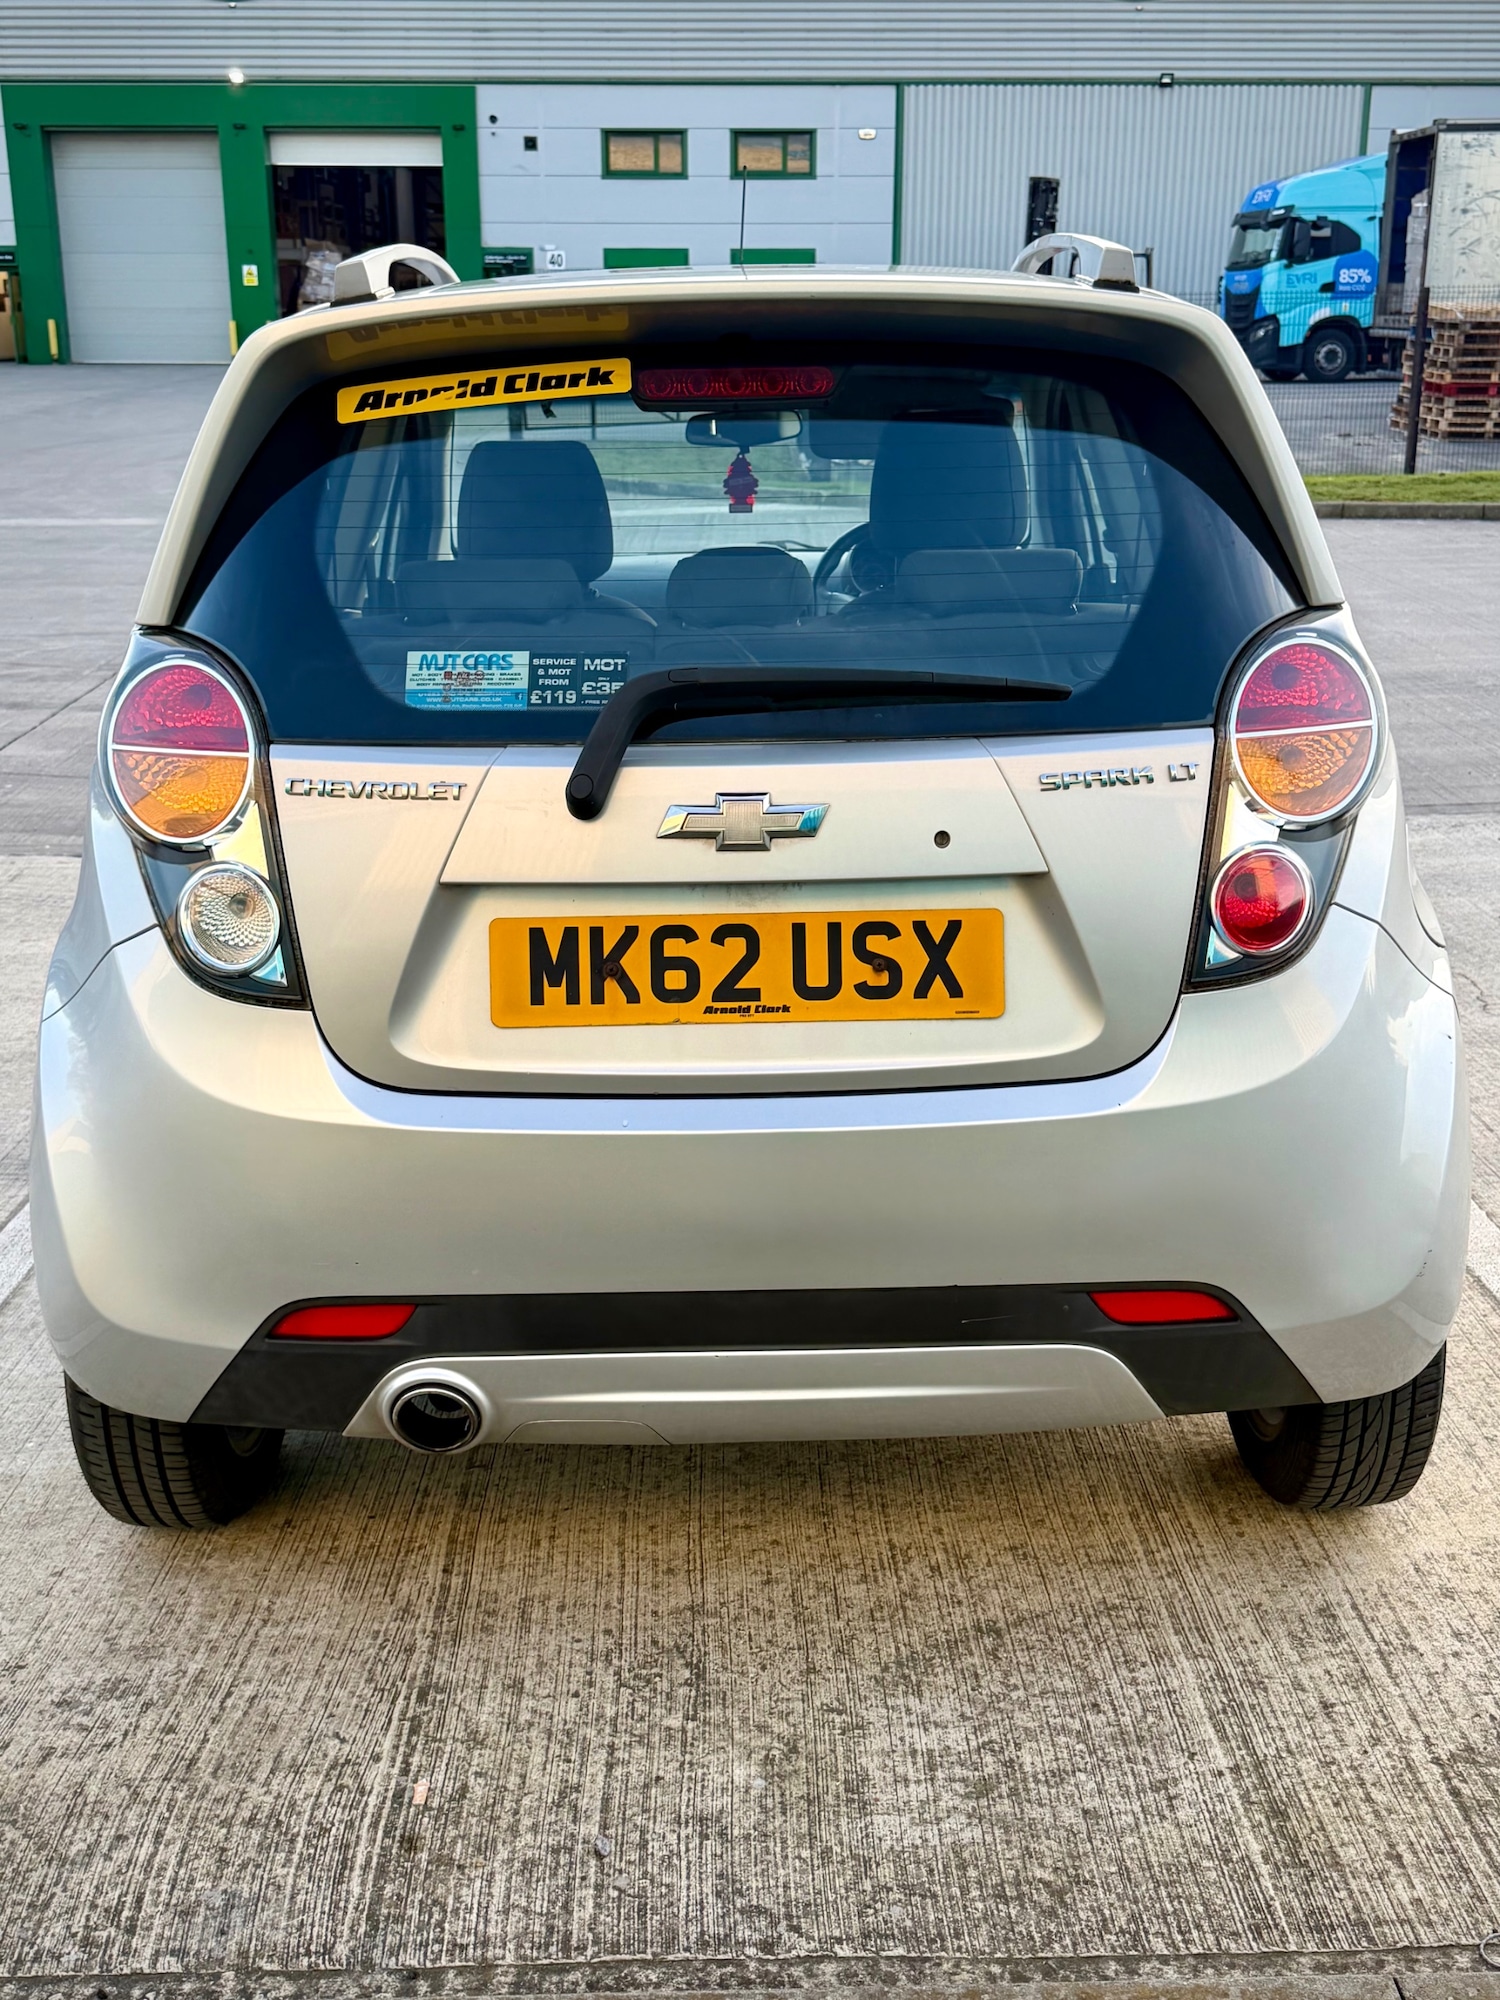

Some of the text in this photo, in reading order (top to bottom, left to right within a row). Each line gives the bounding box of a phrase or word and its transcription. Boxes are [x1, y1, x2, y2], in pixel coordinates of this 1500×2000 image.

[549, 254, 563, 267] 40
[1339, 268, 1372, 283] 85%
[503, 367, 615, 394] Clark
[419, 654, 514, 671] MJT CARS
[532, 658, 577, 666] SERVICE
[583, 658, 626, 671] MOT
[530, 690, 577, 704] £119
[1039, 761, 1200, 792] SPARK LT
[285, 778, 467, 801] CHEVROLET
[528, 919, 964, 1006] MK62 USX
[703, 1004, 791, 1014] Arnold Clark
